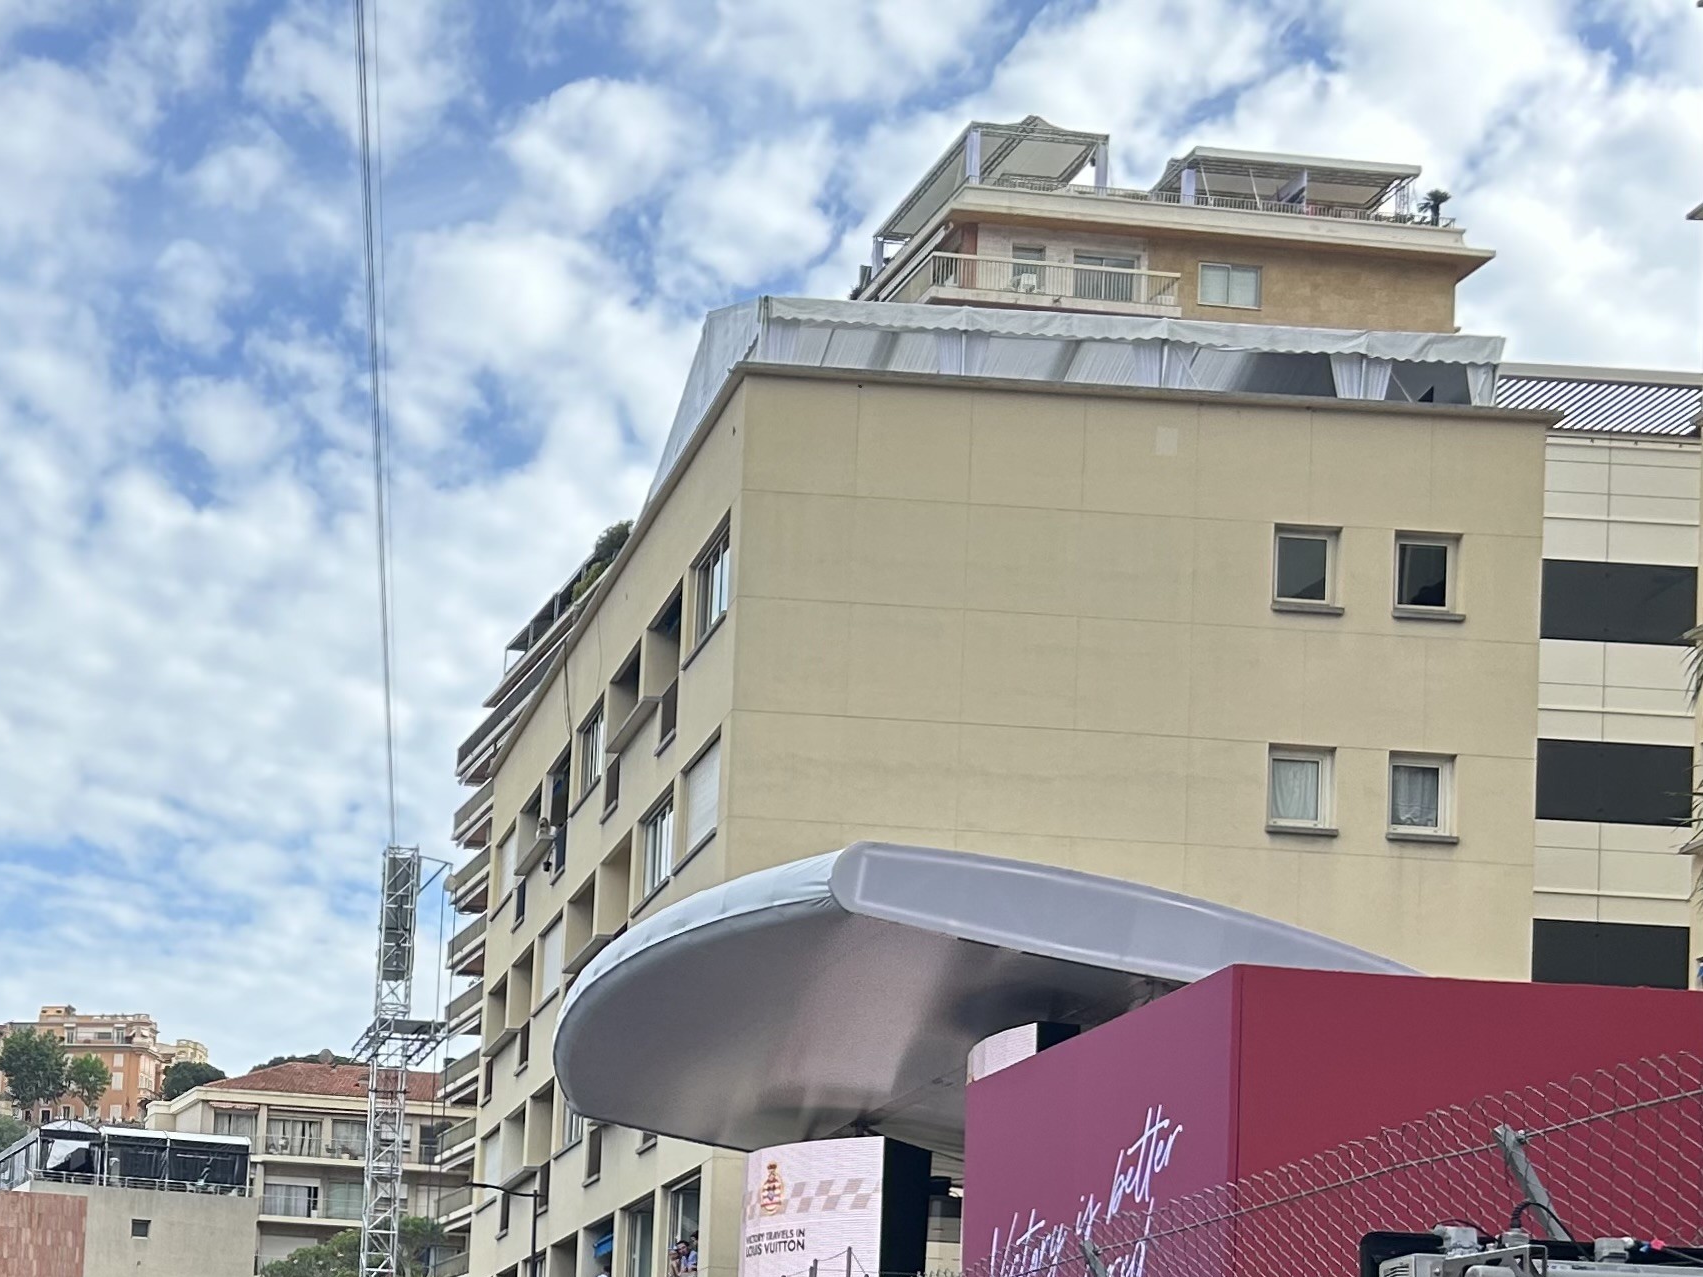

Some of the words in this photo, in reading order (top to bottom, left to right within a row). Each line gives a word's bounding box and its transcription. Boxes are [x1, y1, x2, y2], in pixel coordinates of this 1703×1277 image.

[1106, 1104, 1183, 1225] better
[766, 1229, 794, 1241] TRAVELS
[796, 1228, 805, 1238] IN
[746, 1246, 762, 1257] LOUIS
[763, 1239, 805, 1254] VUITTON
